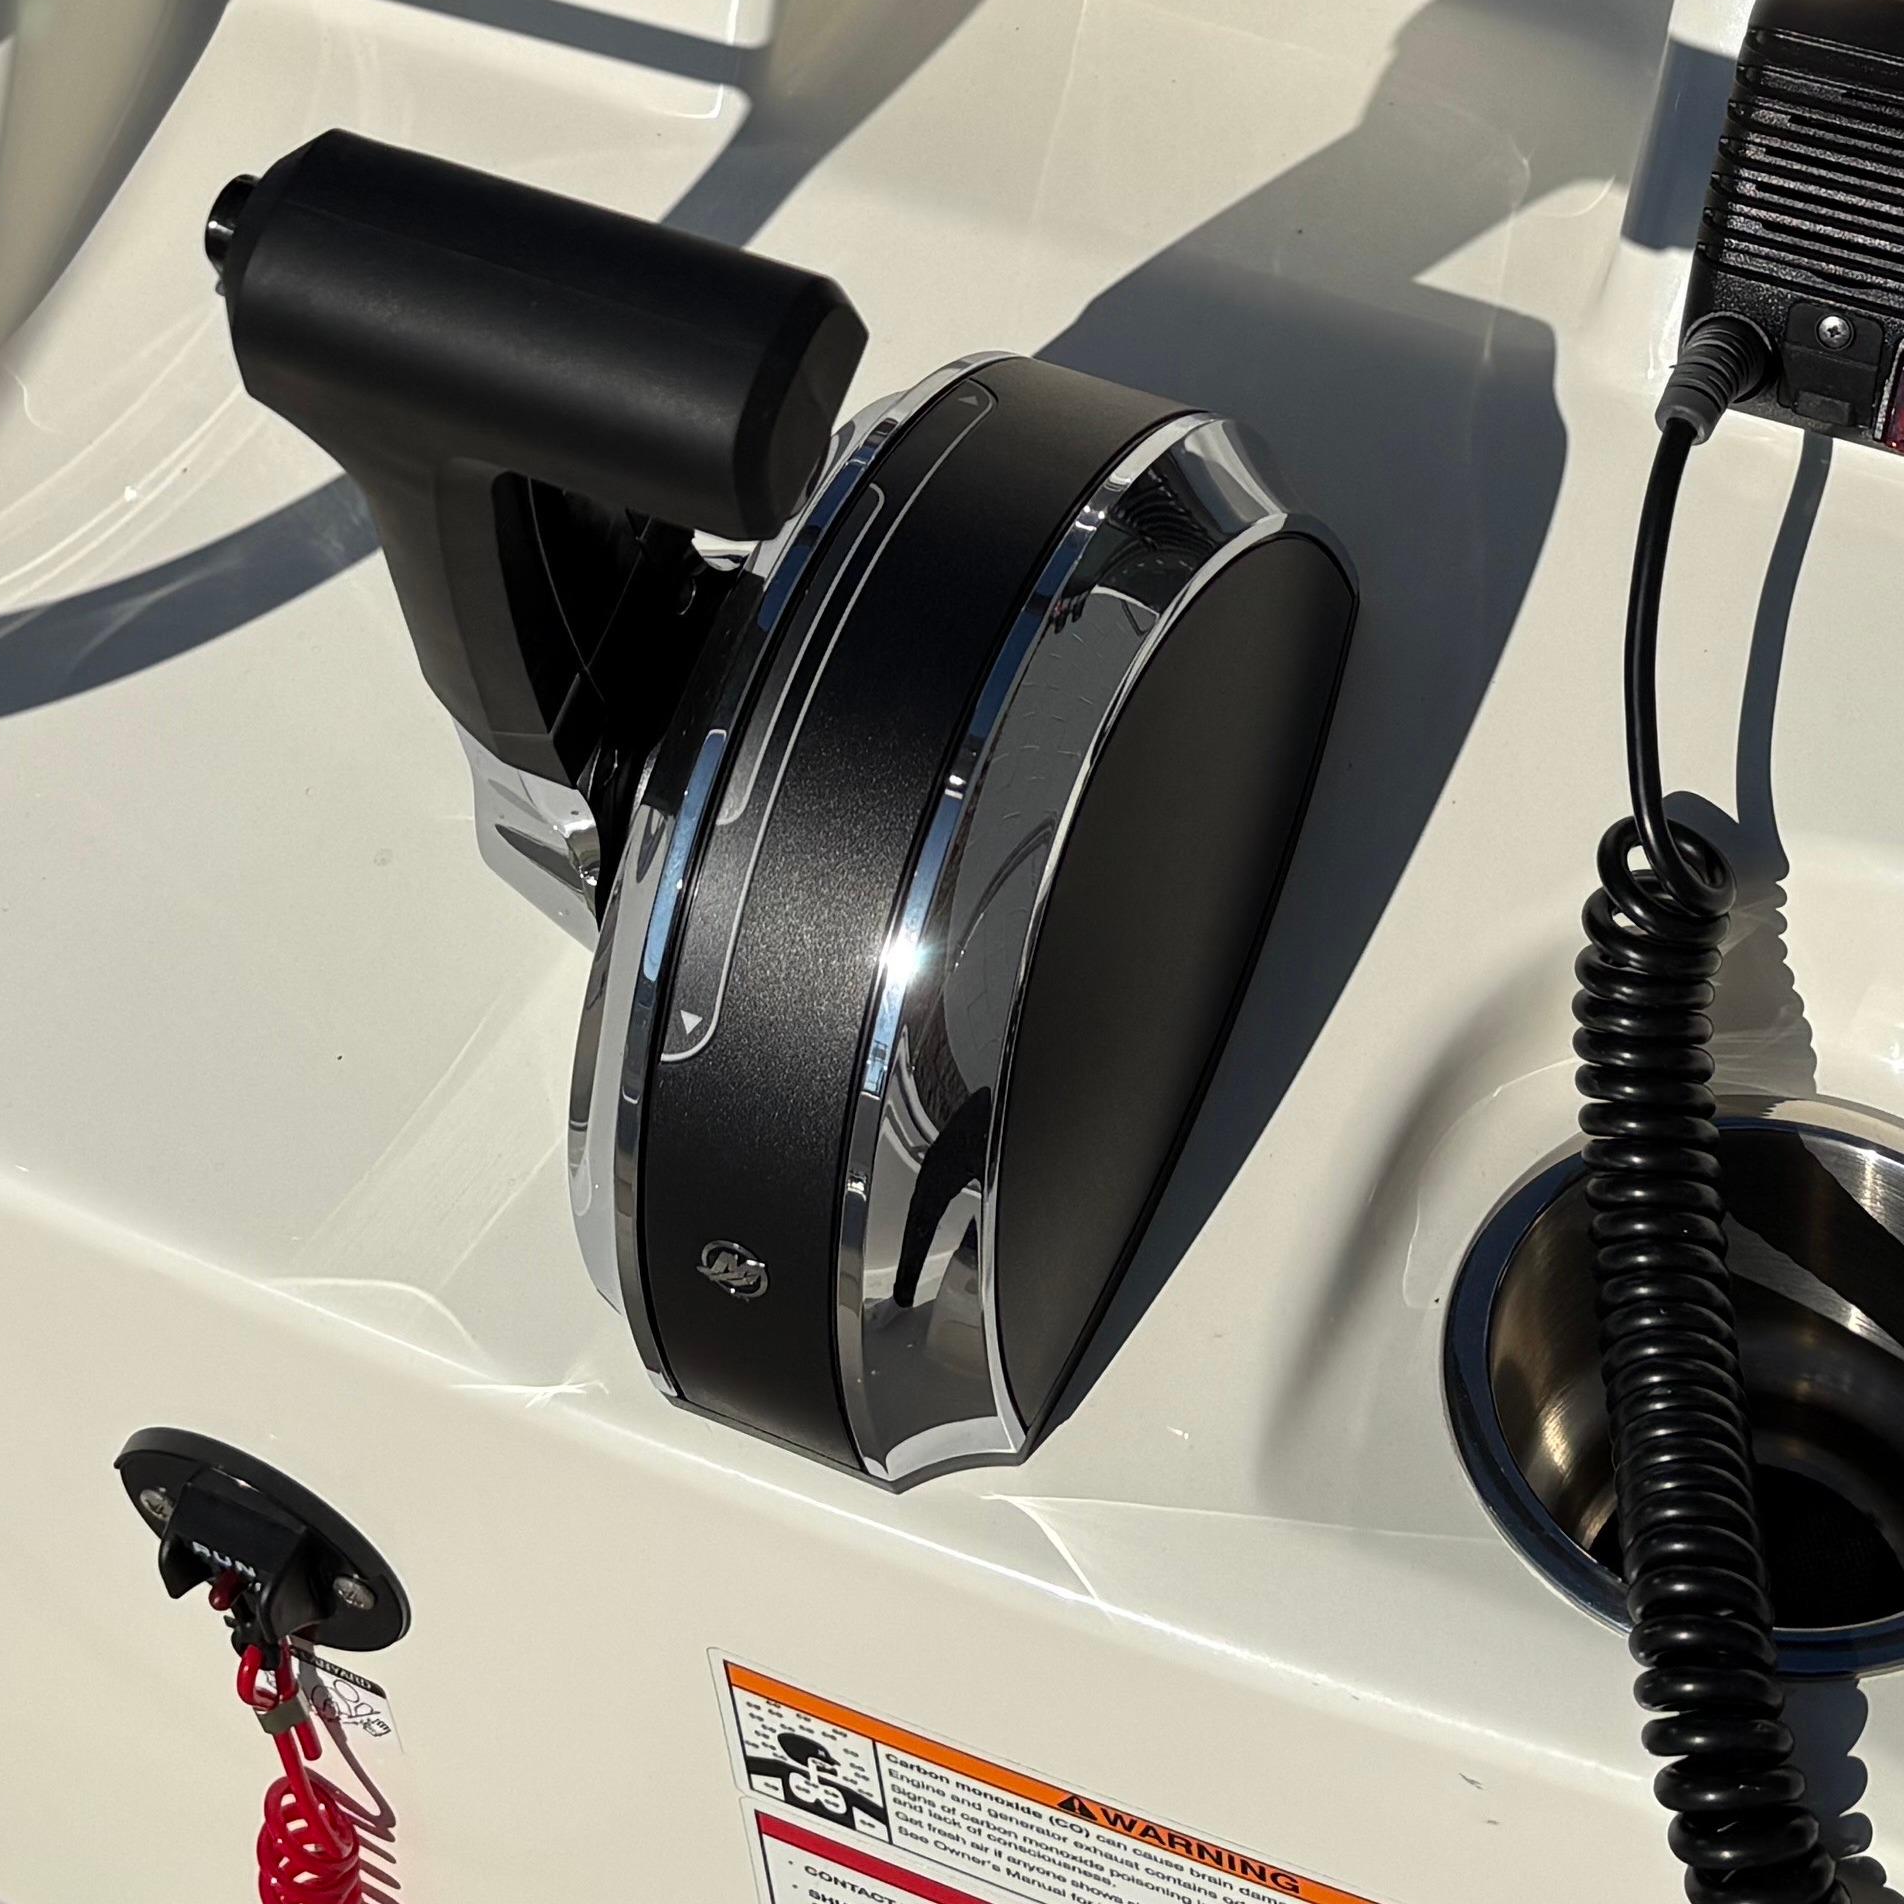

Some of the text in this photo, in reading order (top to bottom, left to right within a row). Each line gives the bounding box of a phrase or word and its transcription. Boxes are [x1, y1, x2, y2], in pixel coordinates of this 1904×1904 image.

[885, 1752, 950, 1785] Carbon
[955, 1780, 1043, 1819] monoxide
[1049, 1814, 1091, 1839] (CO)
[1096, 1832, 1127, 1852] can
[1132, 1845, 1185, 1873] cause
[1189, 1865, 1234, 1891] brain
[887, 1768, 1217, 1899] Engine and generator exhaust contains
[891, 1783, 1193, 1904] Signs of carbon monoxide poisoning
[893, 1797, 924, 1818] and
[928, 1805, 962, 1829] lack
[966, 1821, 982, 1836] of
[895, 1811, 925, 1830] Get
[928, 1820, 967, 1846] fresh
[971, 1840, 993, 1856] air
[1006, 1855, 1068, 1888] anyone
[1070, 1877, 1124, 1904] shows
[897, 1825, 929, 1844] See
[933, 1839, 1001, 1873] Owner's
[1006, 1867, 1067, 1897] Manual
[1099, 1807, 1300, 1894] WARNING
[804, 1865, 897, 1904] CONTACT
